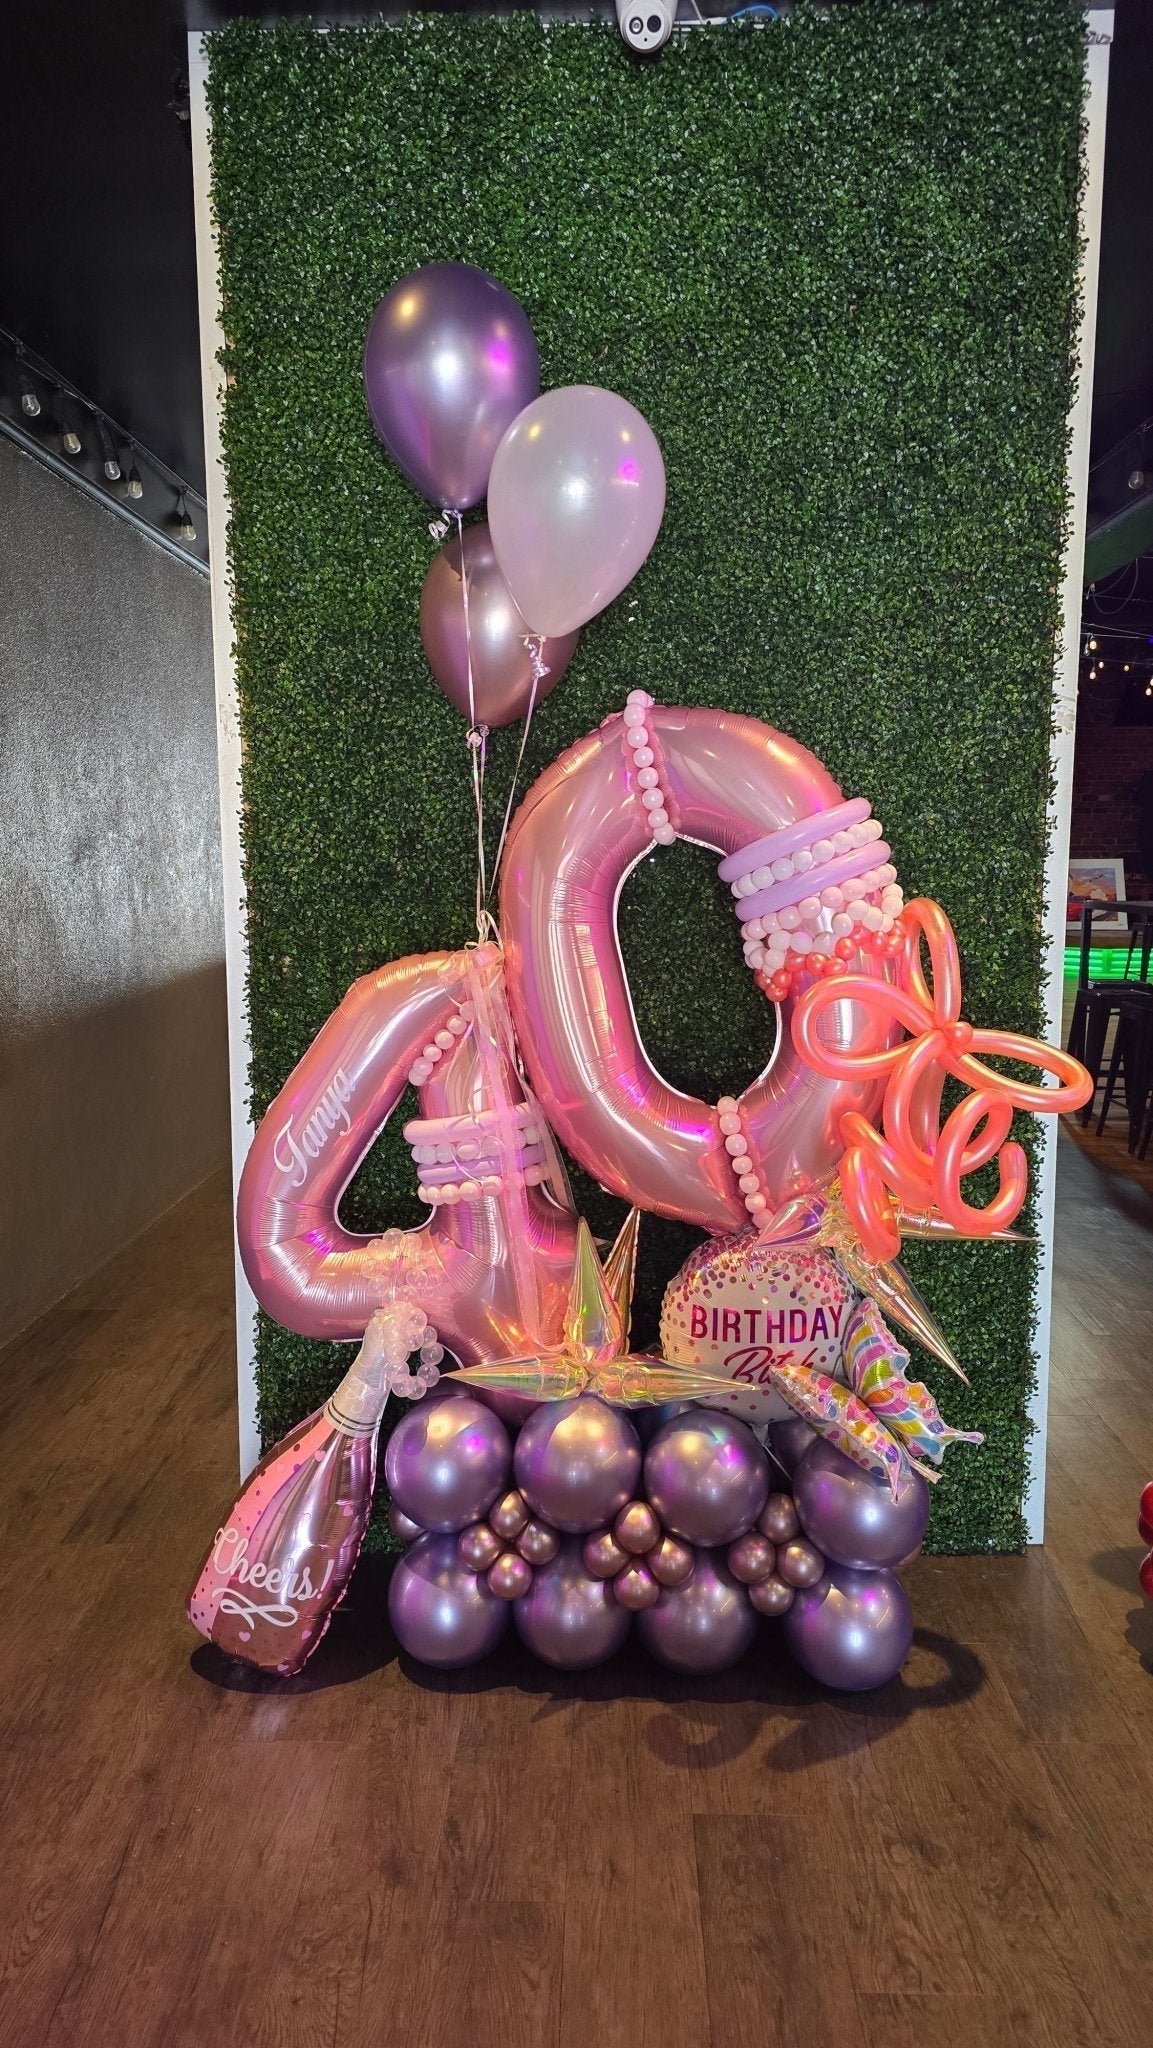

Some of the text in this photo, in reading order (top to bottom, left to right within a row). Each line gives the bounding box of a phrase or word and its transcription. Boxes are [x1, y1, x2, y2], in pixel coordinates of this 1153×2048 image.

[273, 1067, 356, 1188] Tanya
[691, 1304, 843, 1344] BIRTHDAY
[213, 1527, 335, 1600] Cheers!
